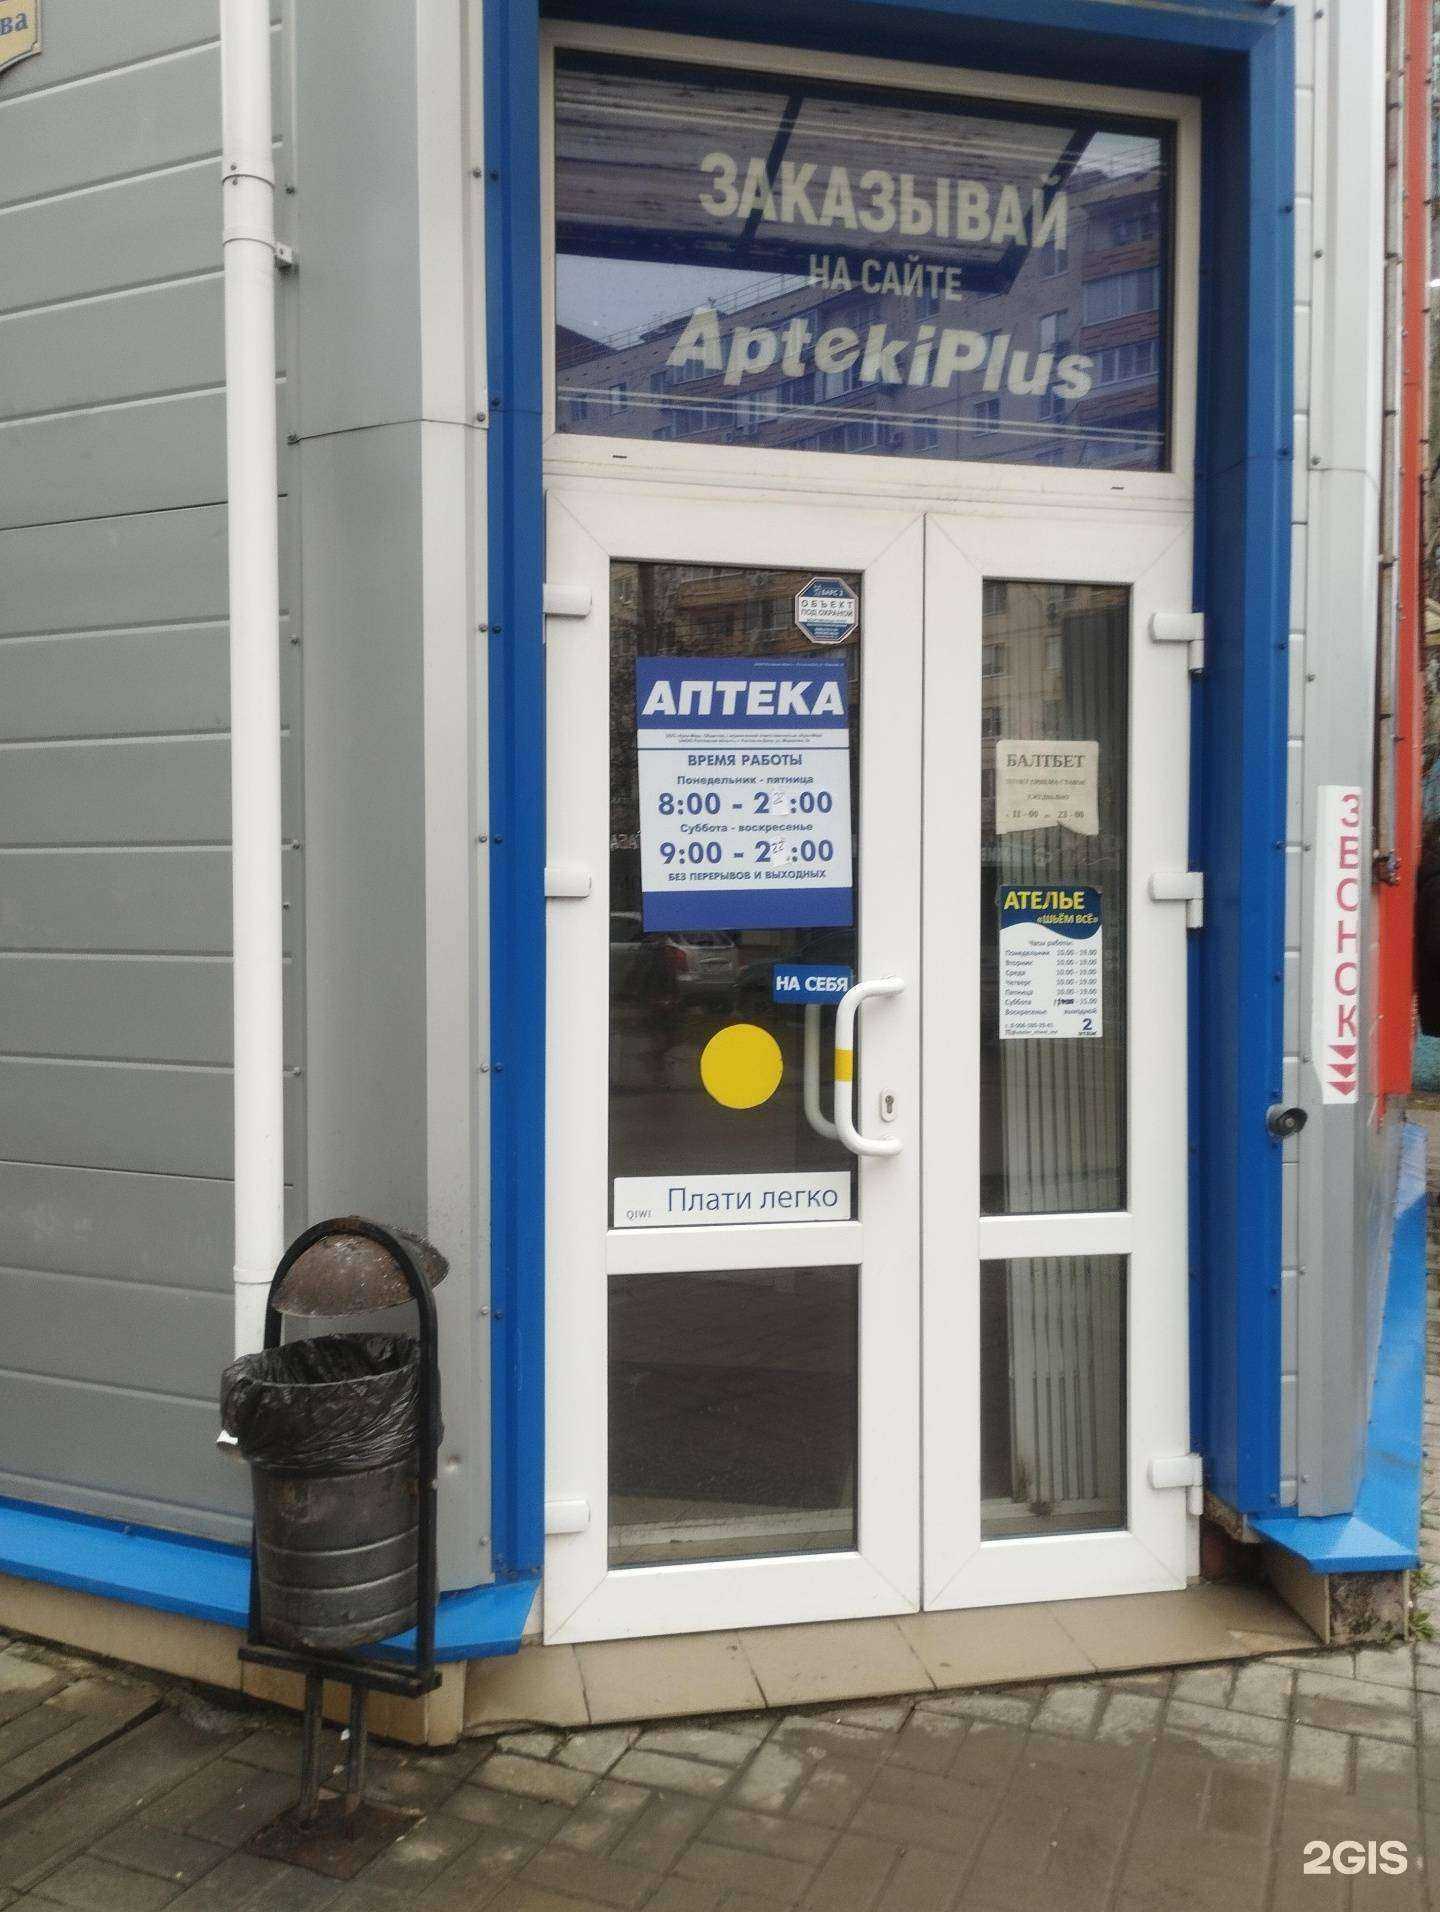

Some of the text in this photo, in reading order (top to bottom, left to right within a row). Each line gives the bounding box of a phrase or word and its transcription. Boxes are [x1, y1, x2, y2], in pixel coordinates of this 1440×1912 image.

[701, 152, 1068, 250] ЗАКАЗЫВАЙ
[809, 254, 962, 301] НА САЙТЕ
[666, 306, 1095, 401] AptekiPlus
[801, 600, 853, 609] ОБЪЕКТ
[641, 680, 845, 716] АПТЕКА
[688, 754, 802, 766] ВРЕМЯ РАБОТЫ
[1006, 753, 1086, 768] БАЛТБЕТ
[677, 775, 757, 786] Понедельник
[767, 776, 814, 786] пятница
[658, 792, 721, 816] 8:00
[680, 823, 728, 835] Суббота
[738, 823, 814, 834] воскресенье
[659, 841, 722, 865] 9:00
[668, 869, 826, 881] БЕЗ ПЕРЕРЫВОВ И ВЫХОДНЫХ
[1003, 891, 1085, 910] АТЕЛЬЕ
[776, 975, 849, 992] НА СЕБЯ
[1083, 1018, 1093, 1031] 2
[668, 1187, 838, 1212] Плати легко
